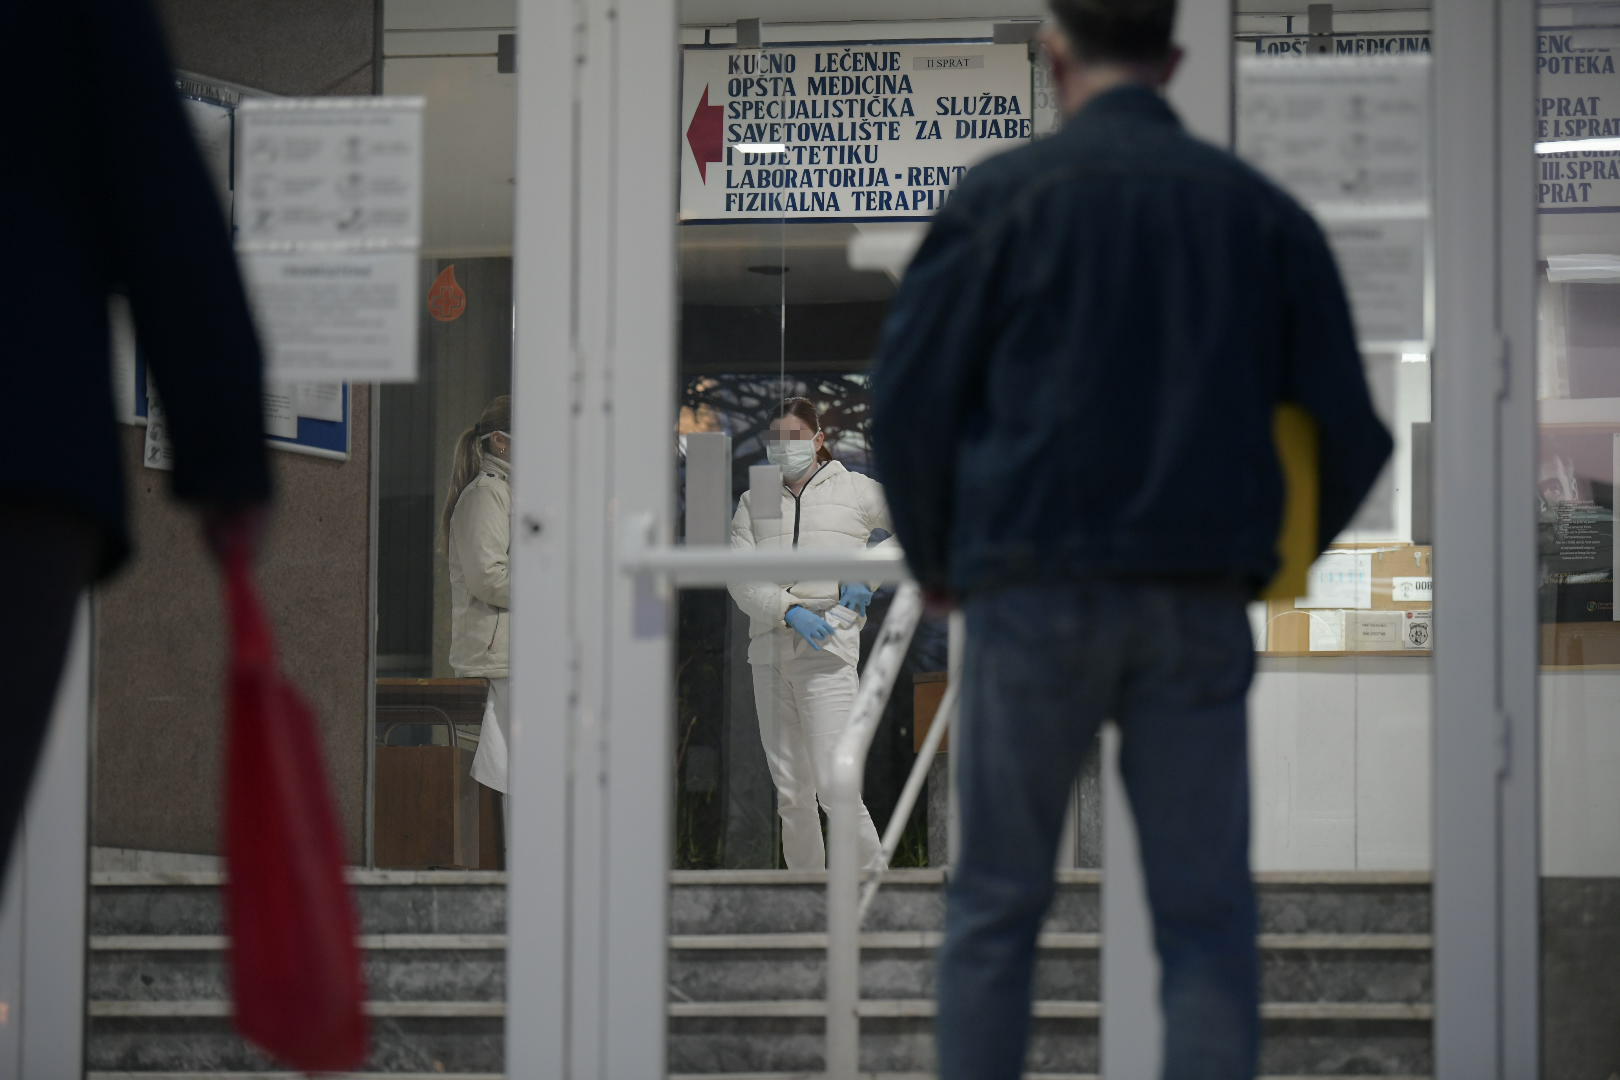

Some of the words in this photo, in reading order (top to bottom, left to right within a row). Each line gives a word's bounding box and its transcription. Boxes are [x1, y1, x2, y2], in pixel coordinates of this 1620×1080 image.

[814, 49, 901, 73] LEČENJE
[936, 58, 970, 68] SPRAT
[728, 75, 796, 97] OPŠTA
[807, 74, 913, 96] MEDICINA
[728, 96, 915, 120] SPECIJALISTIČKA
[935, 92, 1022, 116] SLUŽBA
[727, 119, 901, 143] SAVETOVALIŠTE
[915, 120, 942, 140] ZA
[955, 119, 1031, 139] DIJABE
[743, 144, 878, 165] DIJETETIKU
[726, 168, 889, 188] LABORATORIJA
[1542, 160, 1620, 181] III.SPRA
[725, 191, 840, 212] FIZIKALNA
[851, 189, 954, 210] TERAPIJ
[1537, 182, 1592, 203] PRAT
